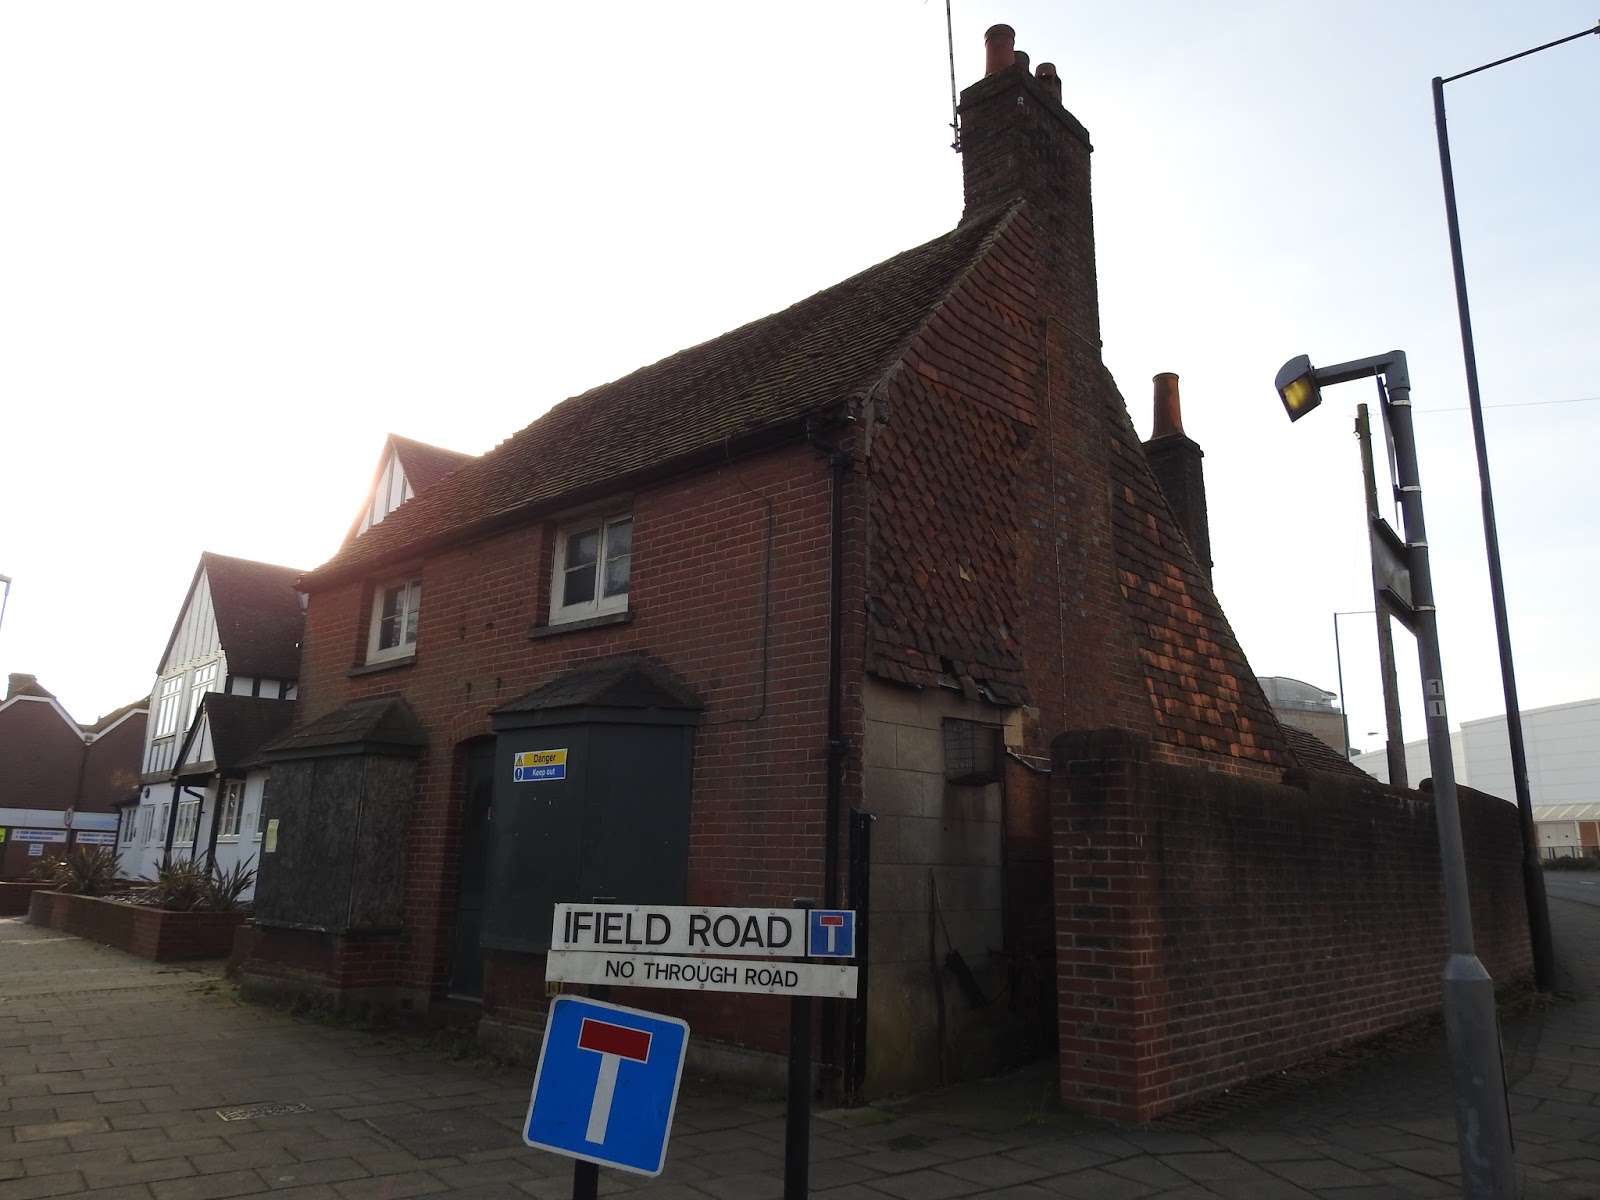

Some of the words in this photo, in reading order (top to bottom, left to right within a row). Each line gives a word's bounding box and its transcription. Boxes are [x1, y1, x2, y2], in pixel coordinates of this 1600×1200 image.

[533, 754, 556, 764] Danger
[532, 769, 546, 777] Keep
[546, 768, 556, 776] out
[563, 911, 671, 945] IFIELD
[688, 914, 793, 948] ROAD
[605, 960, 635, 979] NO
[644, 962, 737, 985] THROUGH
[744, 968, 799, 988] ROAD
